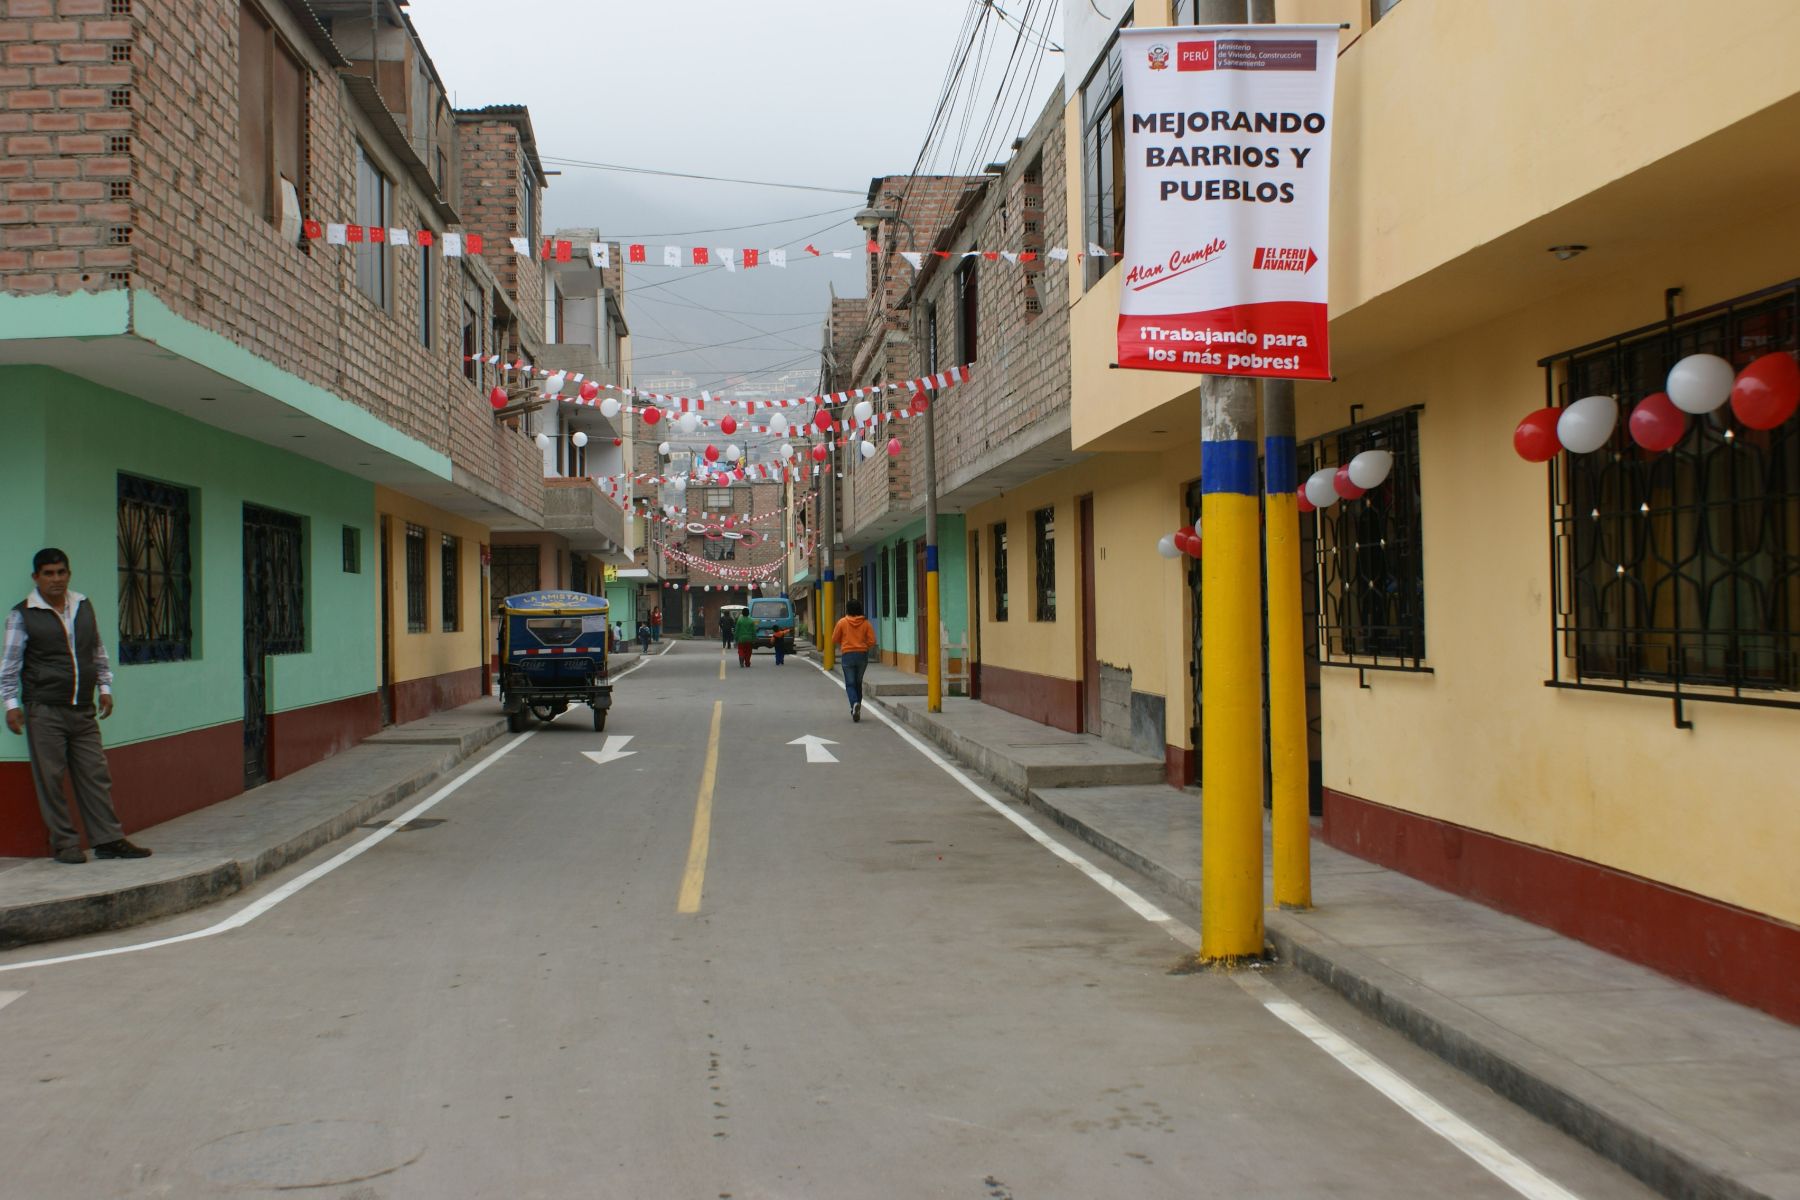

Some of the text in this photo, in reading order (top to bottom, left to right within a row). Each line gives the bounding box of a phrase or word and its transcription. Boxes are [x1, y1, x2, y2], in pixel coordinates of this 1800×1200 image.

[1183, 49, 1209, 61] PERÚ
[1224, 59, 1265, 67] Saneamiento
[1228, 51, 1257, 60] Vivienda,
[1259, 51, 1301, 59] Construcción
[1132, 110, 1326, 139] MEJORANDO
[1146, 145, 1312, 169] BARRIOS Y
[1160, 179, 1295, 204] PUEBLOS
[1125, 237, 1227, 287] Alan Cumple
[1266, 247, 1307, 260] EL PERU
[1263, 259, 1304, 271] AVANZA
[1140, 326, 1308, 349] ¡Trabajando para
[1148, 347, 1300, 370] los más pobres!
[523, 593, 588, 603] LA AMISTAD
